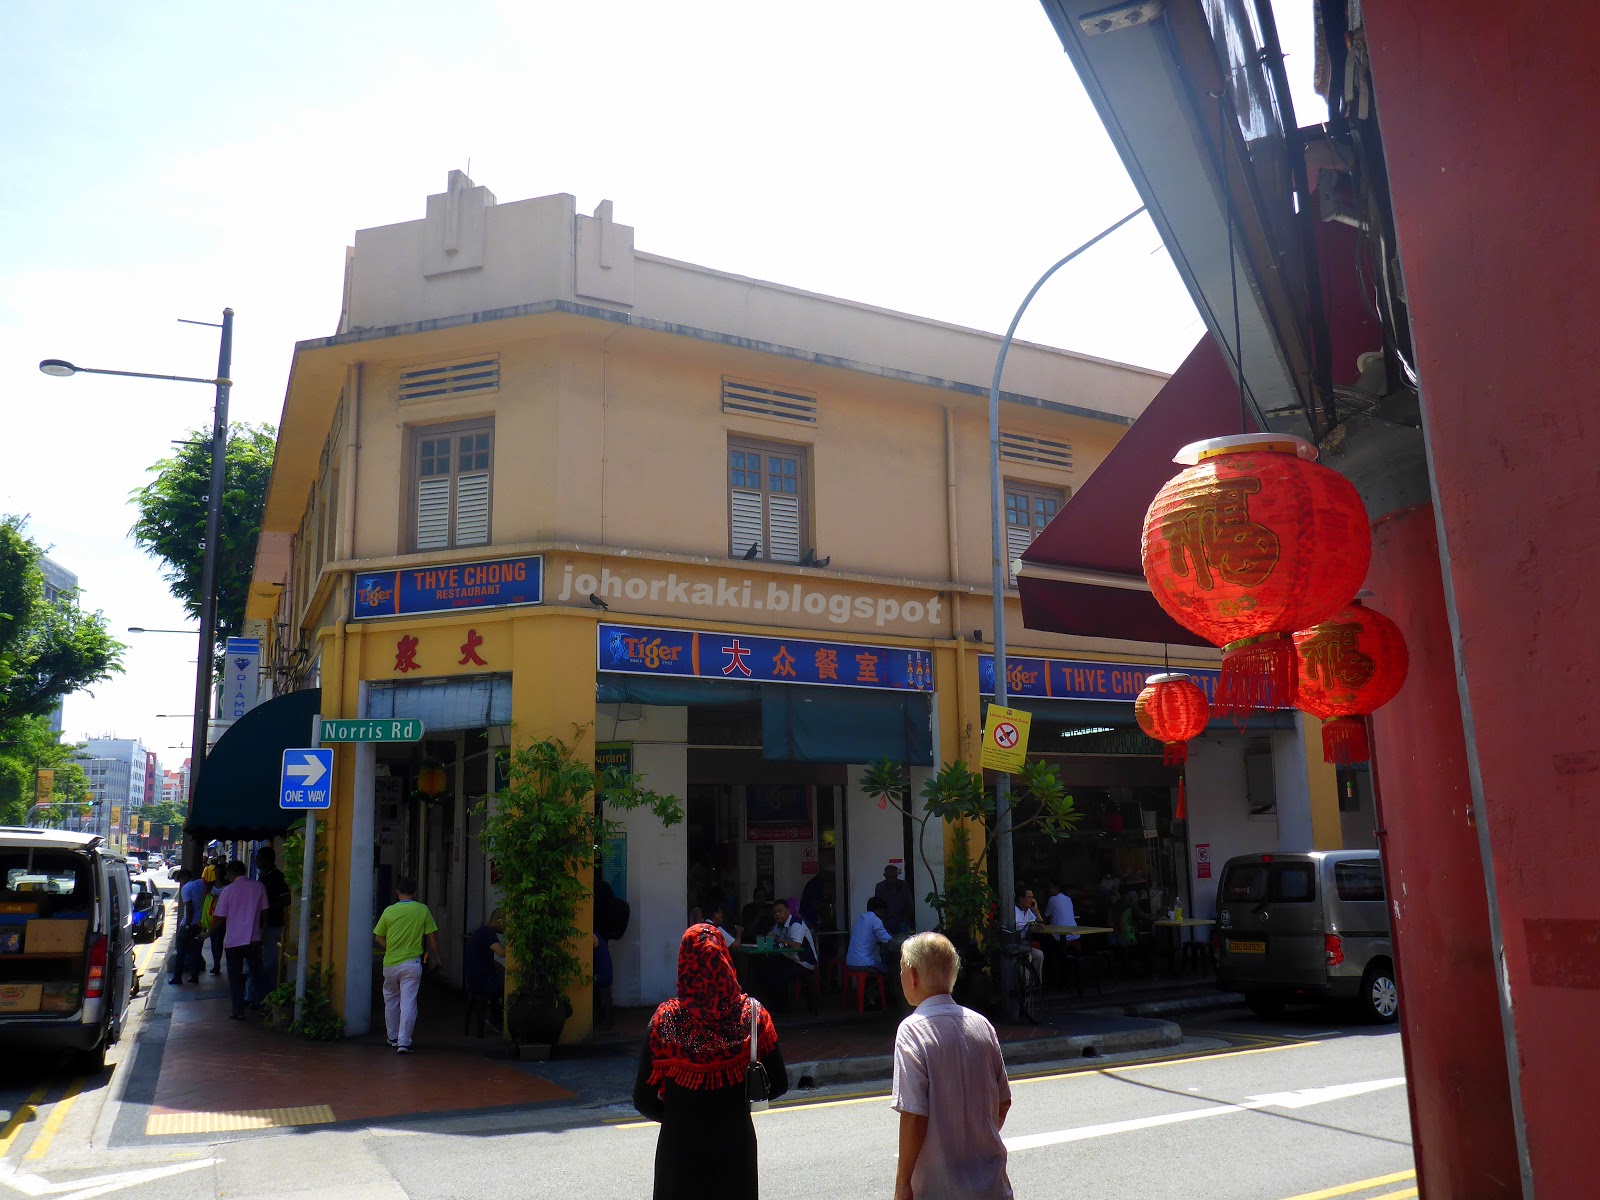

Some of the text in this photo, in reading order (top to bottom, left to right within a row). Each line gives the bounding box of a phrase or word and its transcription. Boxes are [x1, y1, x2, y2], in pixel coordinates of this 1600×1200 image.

[414, 562, 527, 590] THYE CHONG
[357, 586, 394, 607] Tiger
[436, 584, 501, 600] RESTAURANT
[623, 637, 683, 669] Tiger
[1006, 664, 1039, 692] iger
[1062, 668, 1153, 695] THYE CHO
[325, 722, 413, 740] Norris Rd
[285, 789, 327, 803] ONE WAY
